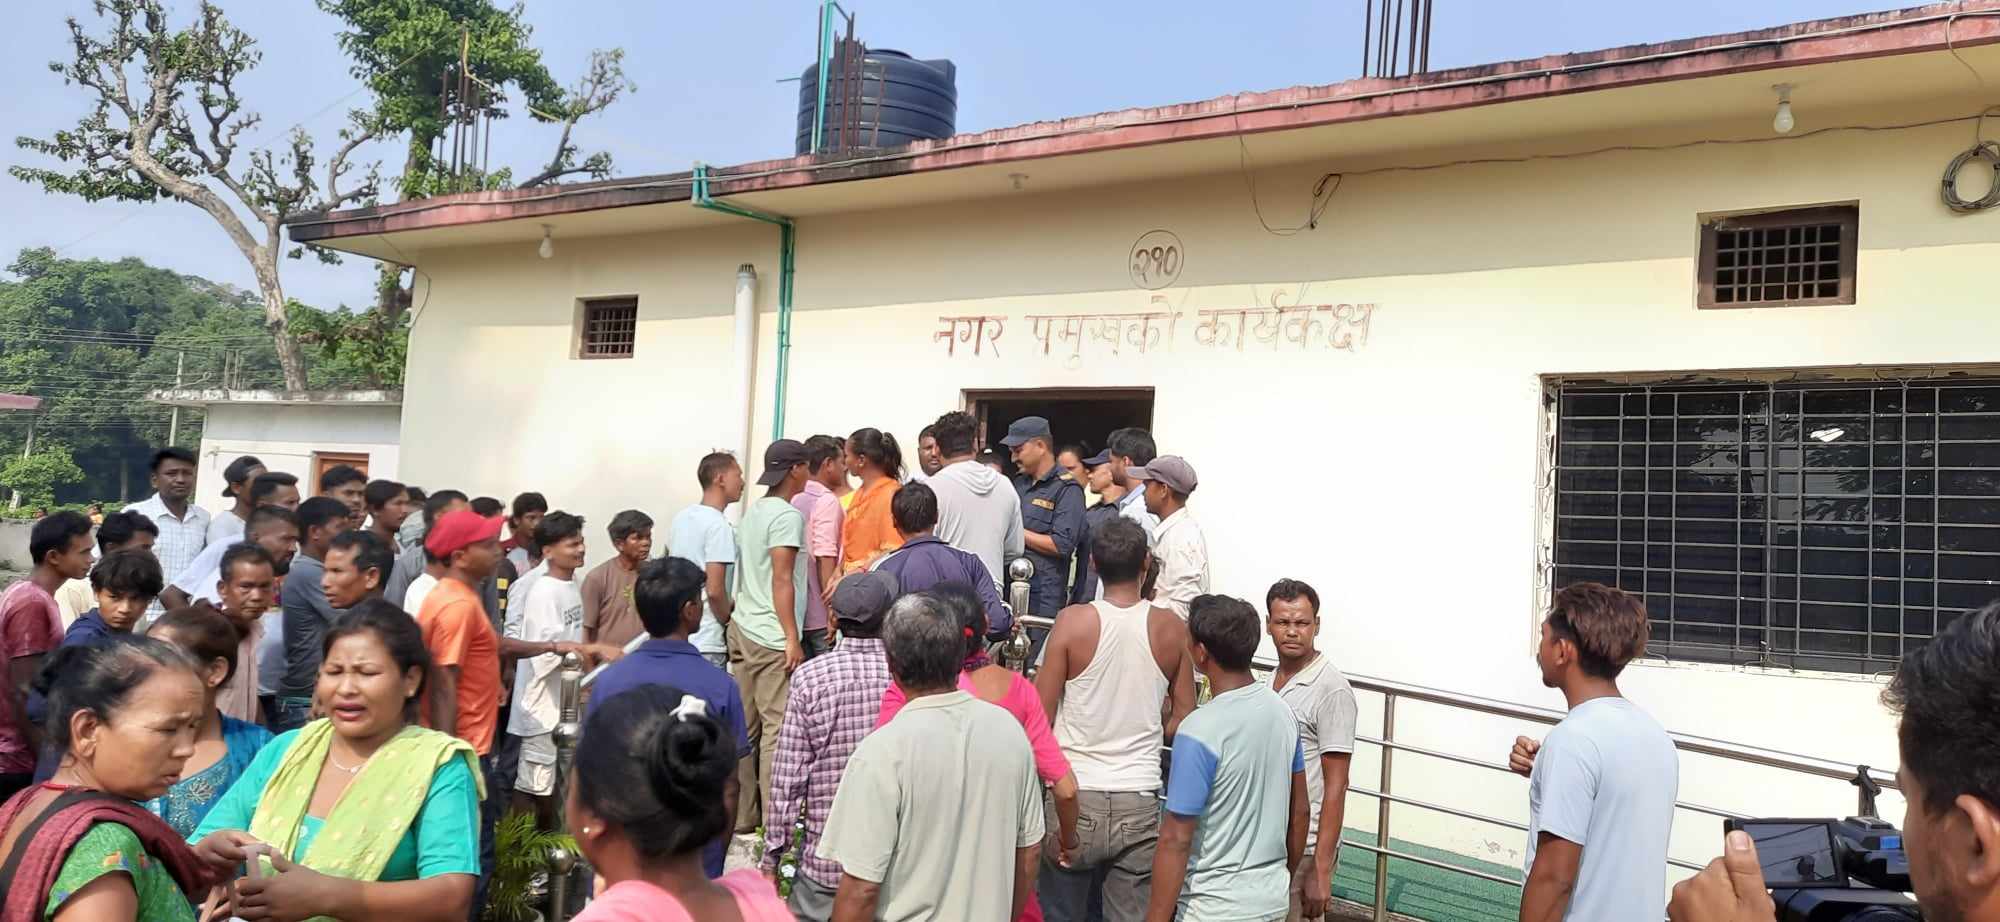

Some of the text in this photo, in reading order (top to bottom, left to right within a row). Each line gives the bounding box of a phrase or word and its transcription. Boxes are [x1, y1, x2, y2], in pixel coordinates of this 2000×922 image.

[1133, 245, 1179, 284] २१०
[933, 315, 1009, 358] नगर
[1194, 289, 1377, 353] कार्यकक्ष
